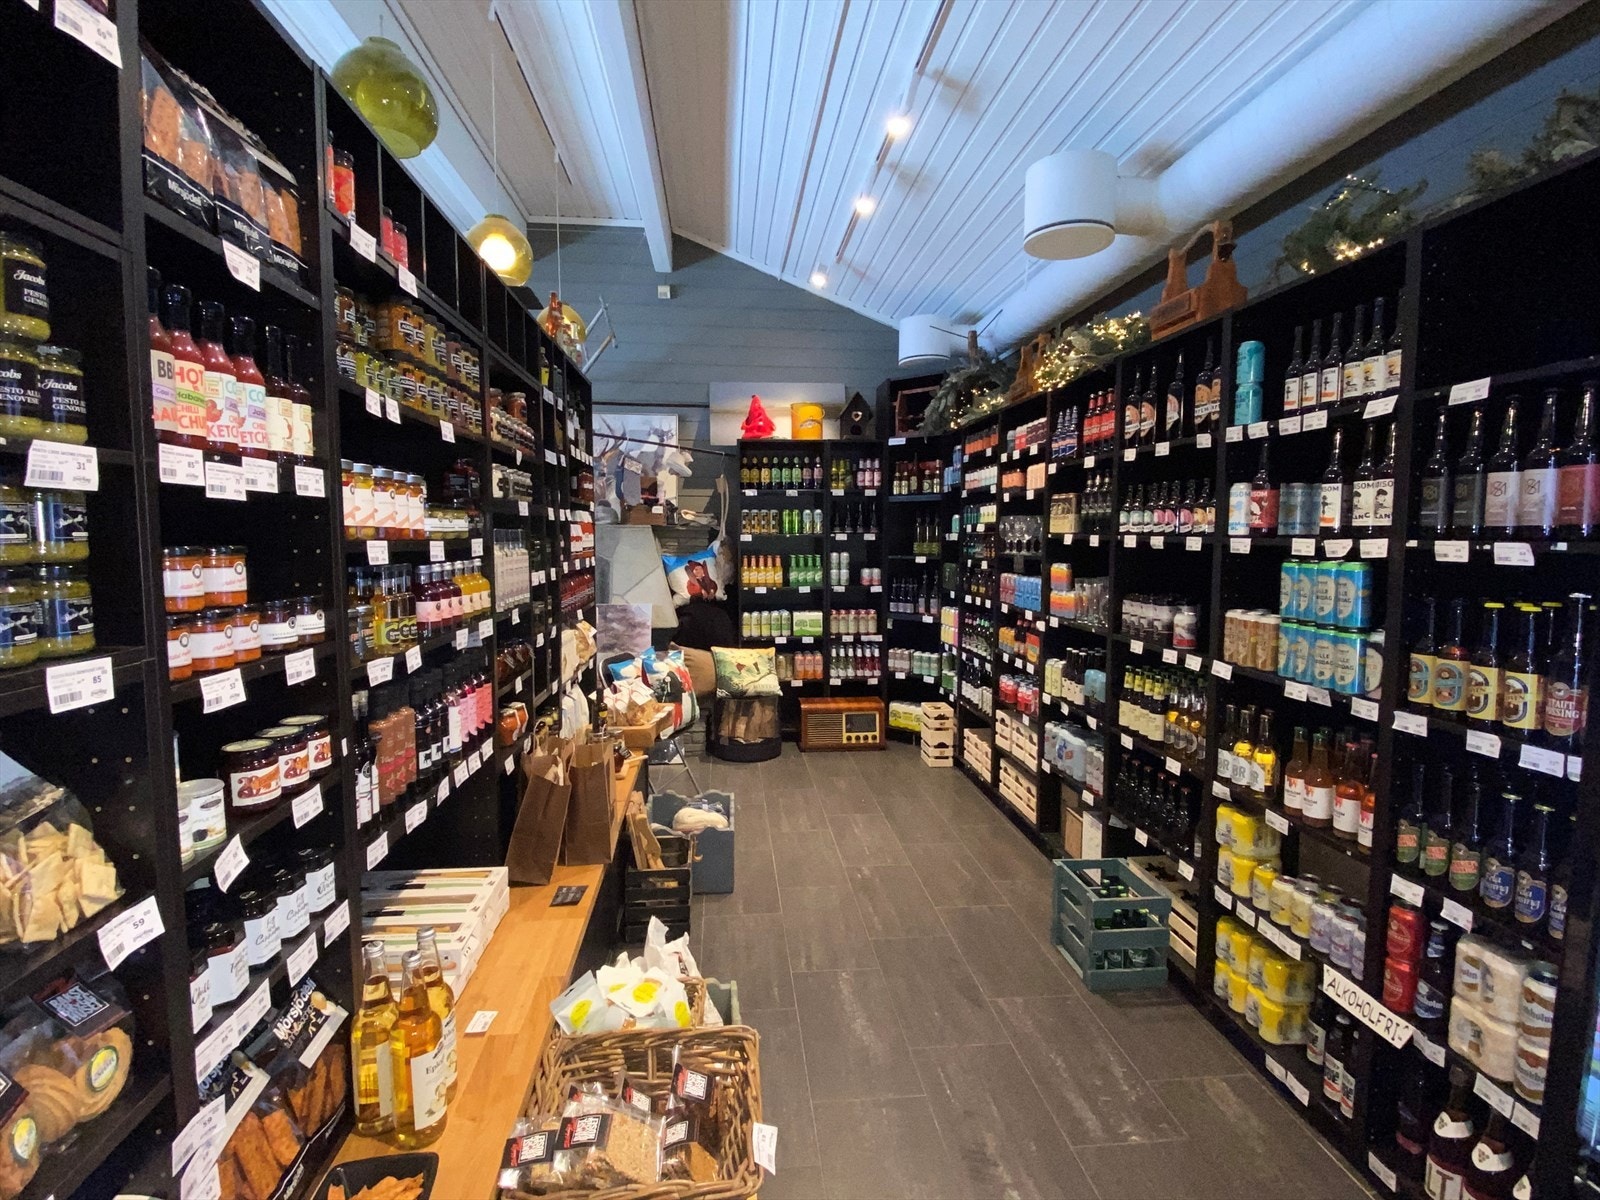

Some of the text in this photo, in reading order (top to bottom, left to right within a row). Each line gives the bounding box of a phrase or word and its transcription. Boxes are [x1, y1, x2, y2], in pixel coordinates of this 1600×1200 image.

[41, 379, 78, 391] Jacobs
[76, 461, 86, 470] 31
[132, 918, 145, 930] 59
[1326, 977, 1401, 1042] ALKOHOLFRI
